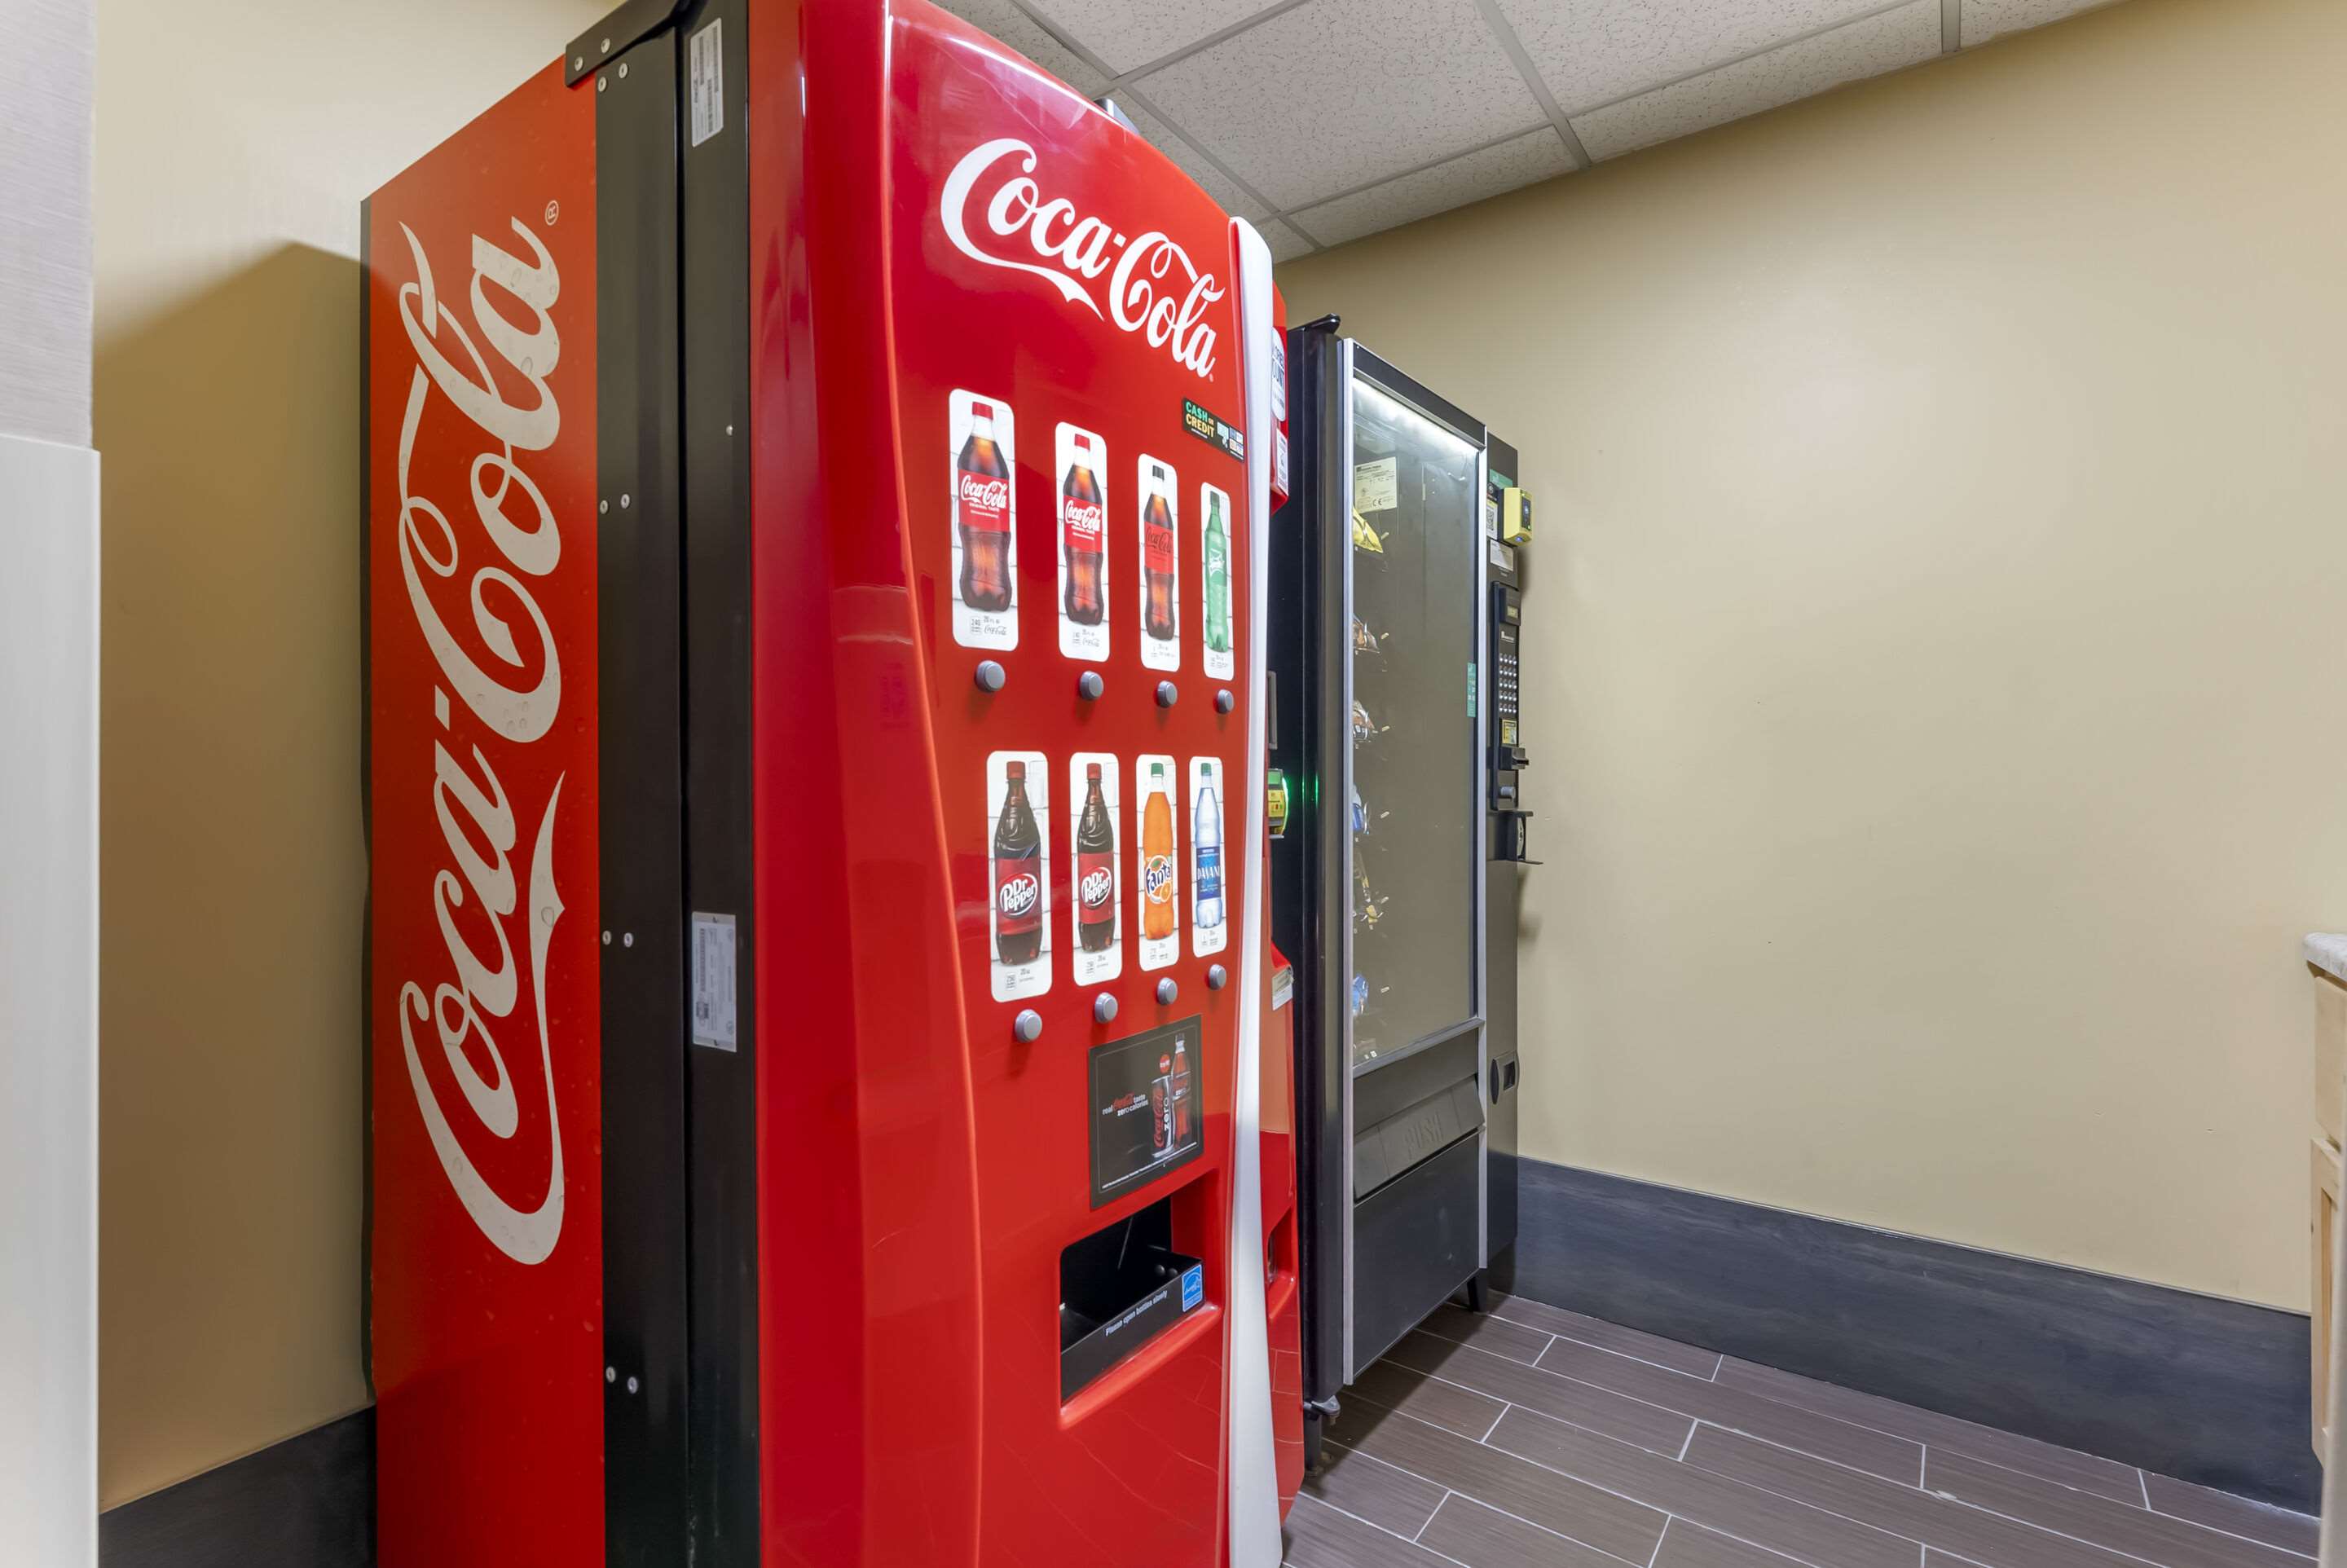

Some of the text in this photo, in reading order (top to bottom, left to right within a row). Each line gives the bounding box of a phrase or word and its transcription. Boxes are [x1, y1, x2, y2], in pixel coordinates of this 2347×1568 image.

[940, 138, 1226, 378] Coca-Cola
[1186, 401, 1208, 422] CASH
[1186, 413, 1214, 438] CREDIT
[961, 474, 1008, 509] Coca-Cola
[1065, 500, 1102, 532] Coca-Cola
[1147, 526, 1174, 554] Coca-Cola
[399, 216, 566, 1266] Coca-Cola
[1013, 879, 1028, 893] Dr
[1082, 876, 1111, 903] Pepper
[1091, 872, 1104, 886] Dr
[1003, 883, 1036, 913] Pepper
[1403, 1110, 1445, 1161] PUSH
